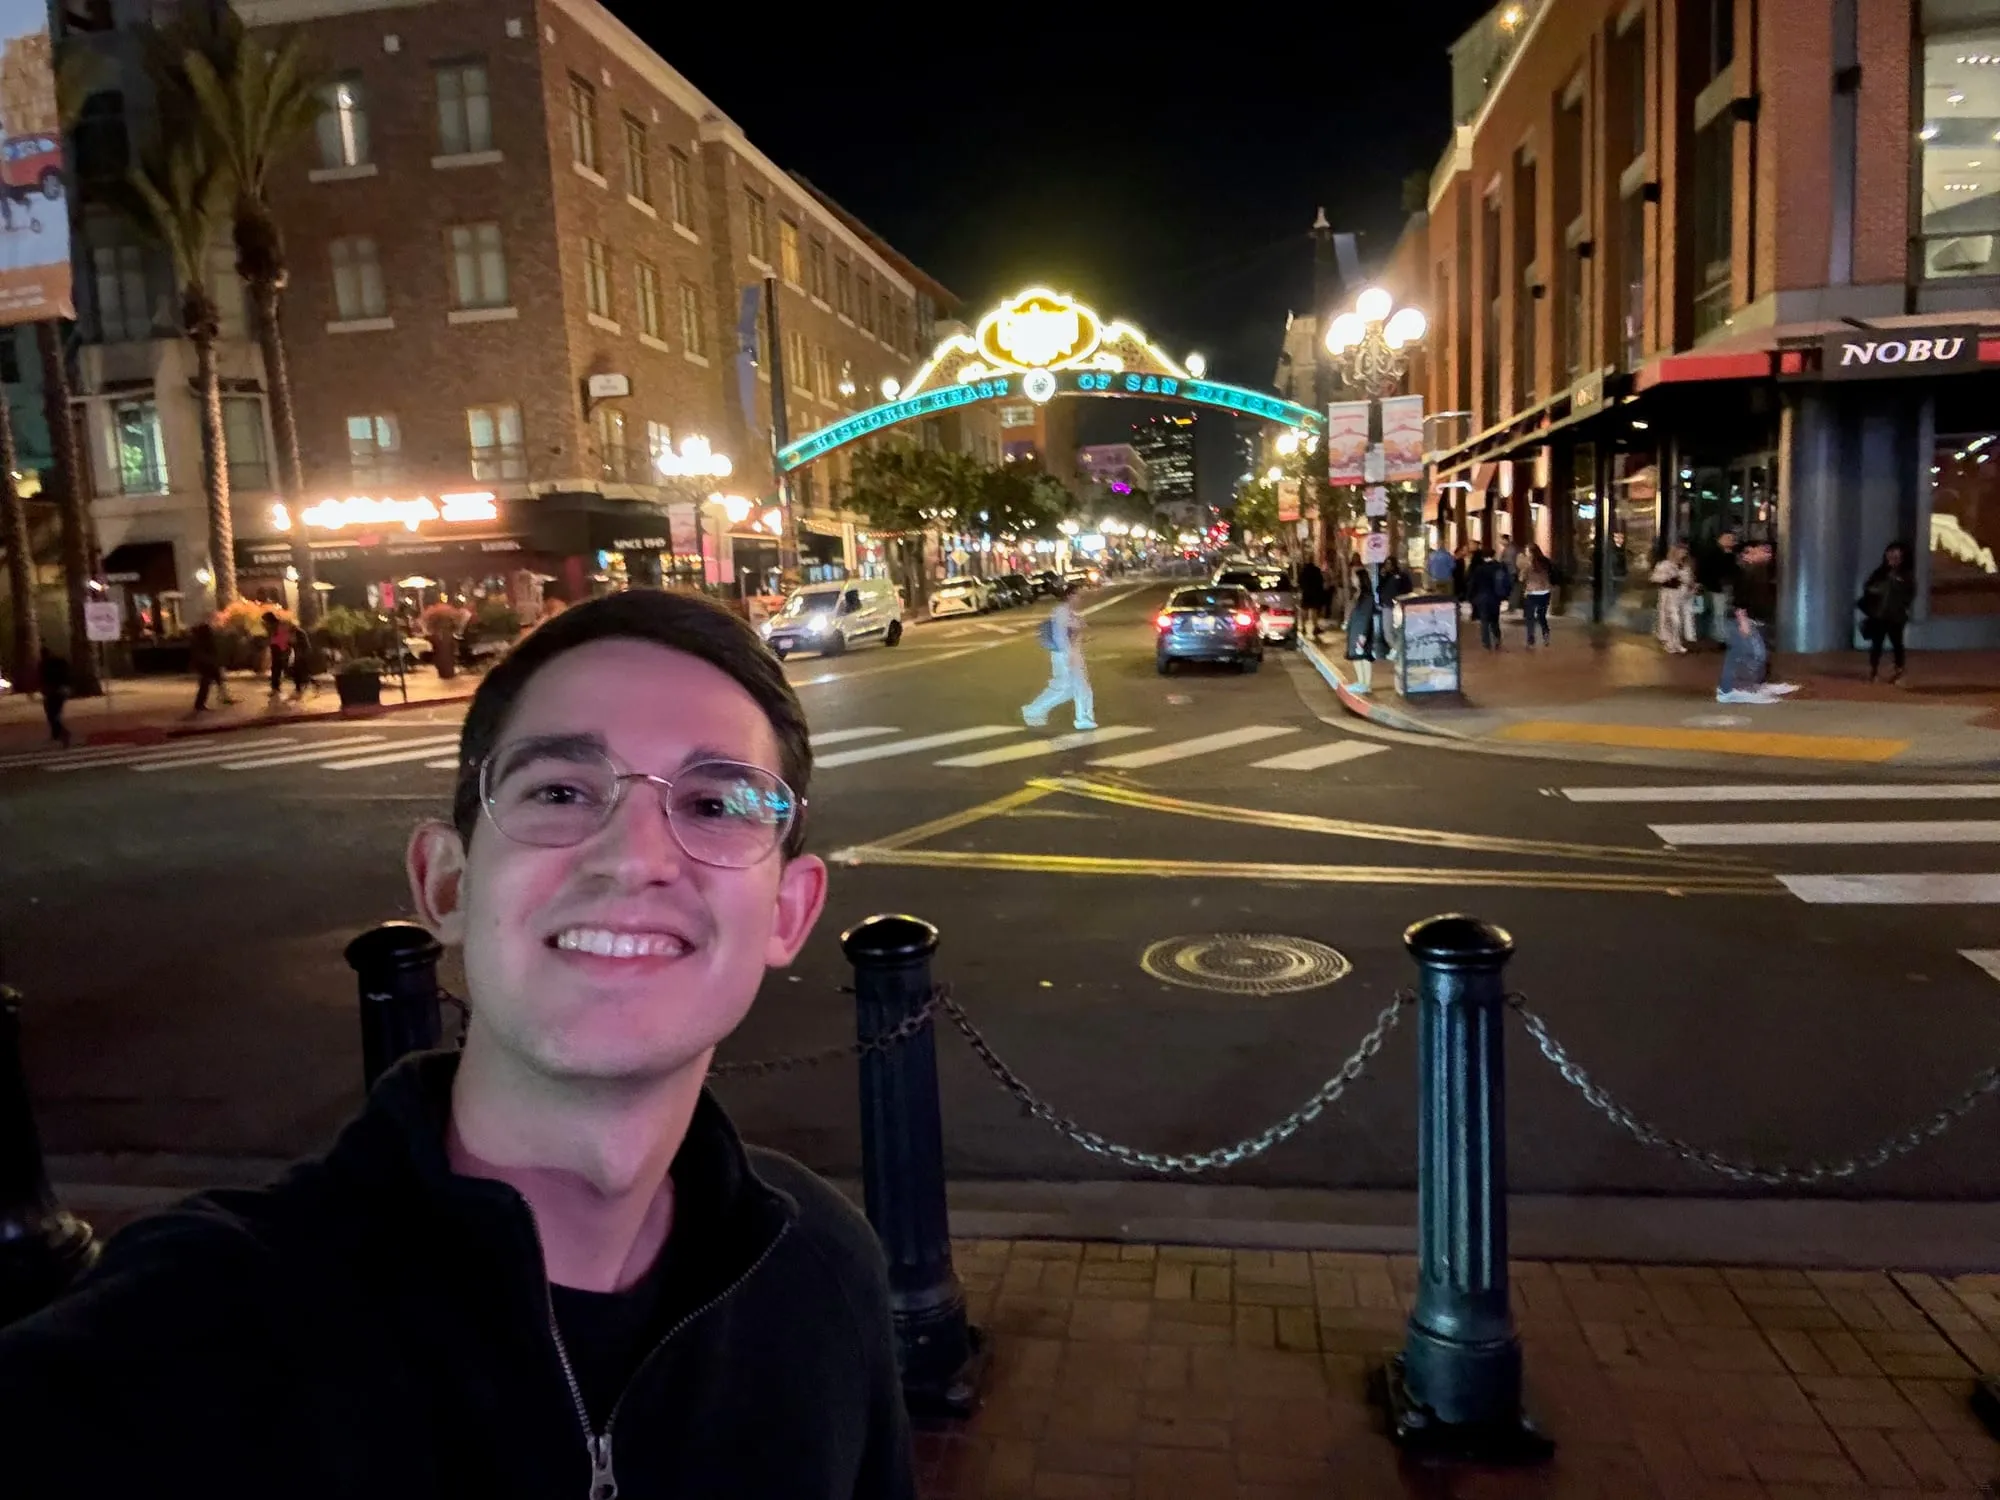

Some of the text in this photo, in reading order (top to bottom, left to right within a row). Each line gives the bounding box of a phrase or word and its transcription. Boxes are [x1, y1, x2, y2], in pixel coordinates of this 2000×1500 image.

[1840, 337, 1965, 366] NOBU
[813, 399, 922, 451] HISTORIC
[931, 378, 1009, 409] HEART
[1077, 372, 1112, 391] OF
[1125, 373, 1179, 396] SAN
